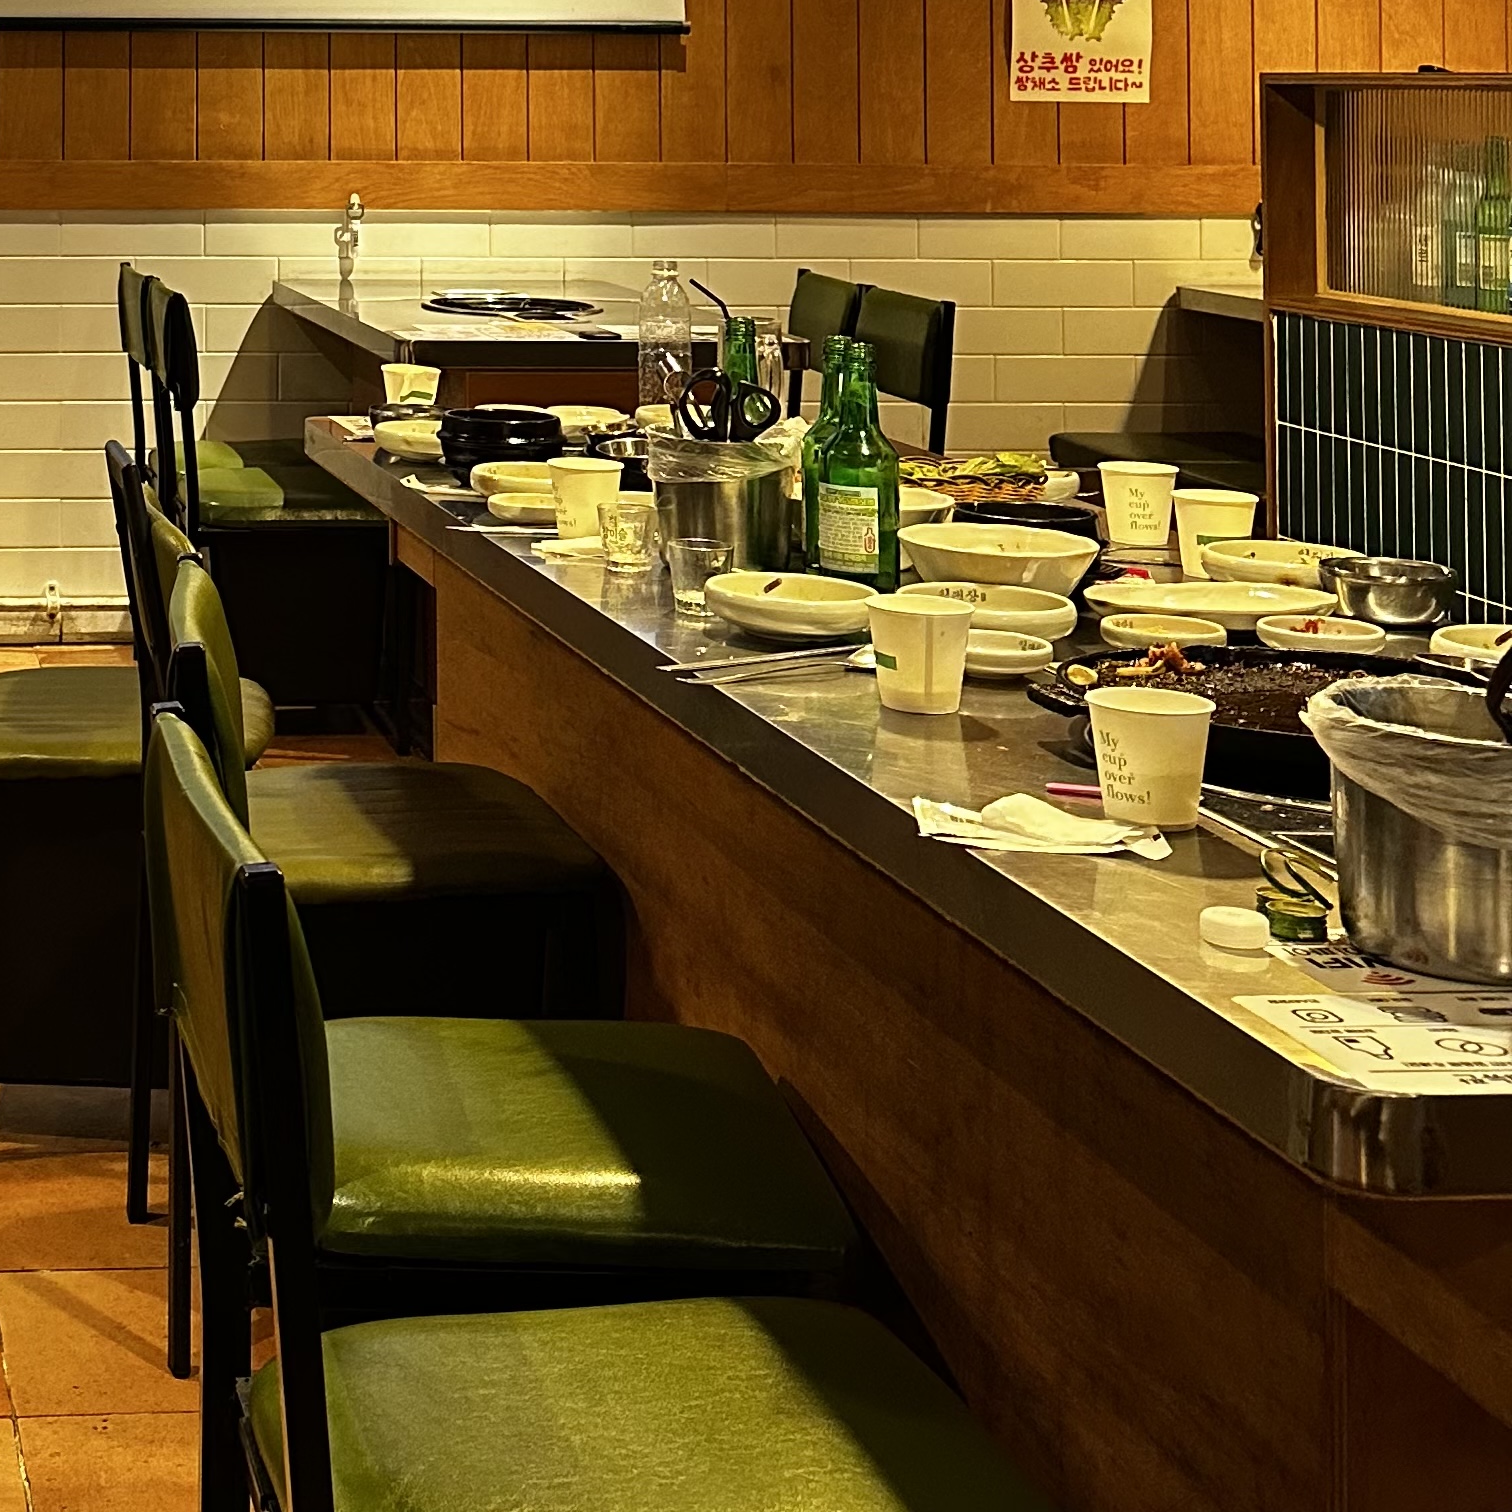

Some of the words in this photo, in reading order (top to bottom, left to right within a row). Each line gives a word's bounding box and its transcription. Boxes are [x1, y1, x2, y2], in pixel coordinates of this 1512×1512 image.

[1015, 51, 1084, 74] 상추쌈
[1088, 57, 1144, 74] 있어요!
[1014, 76, 1061, 92] 쌈채소
[1066, 76, 1144, 93] 드립니다~
[1128, 487, 1145, 501] My
[1128, 500, 1150, 512] cup
[1129, 512, 1155, 520] over
[1130, 520, 1162, 531] flows!
[1099, 729, 1120, 753] My
[1102, 752, 1128, 772] cup
[1104, 770, 1136, 786] over
[1106, 783, 1152, 805] flows!
